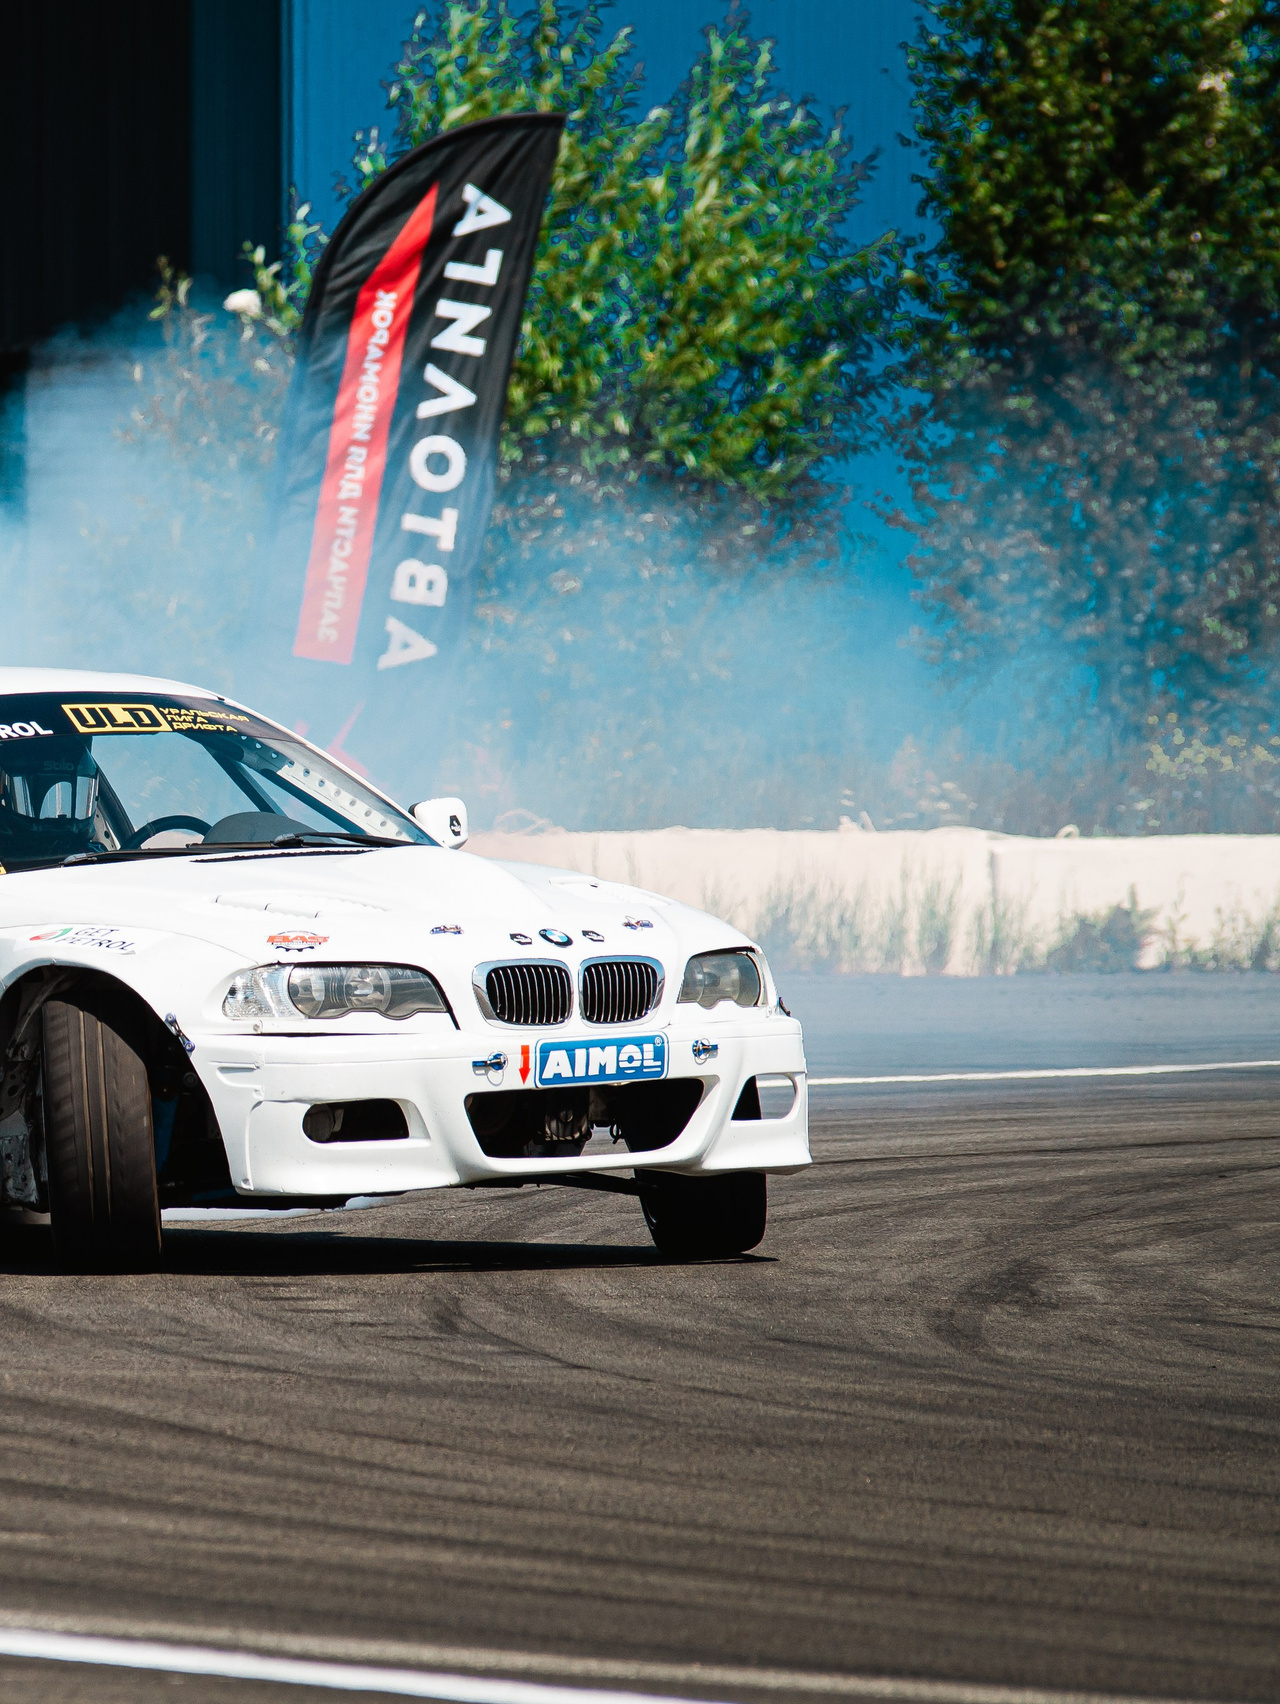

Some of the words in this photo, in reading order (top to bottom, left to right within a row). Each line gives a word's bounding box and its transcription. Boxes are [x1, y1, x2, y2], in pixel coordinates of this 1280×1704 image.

[69, 707, 163, 729] ULD
[158, 707, 250, 723] УРАЛЬСКАЯ
[165, 714, 209, 724] ЛИГА
[172, 721, 238, 733] ДРИФТА
[74, 927, 120, 937] GET
[55, 936, 135, 951] PETROL
[541, 1043, 661, 1079] AIMOL
